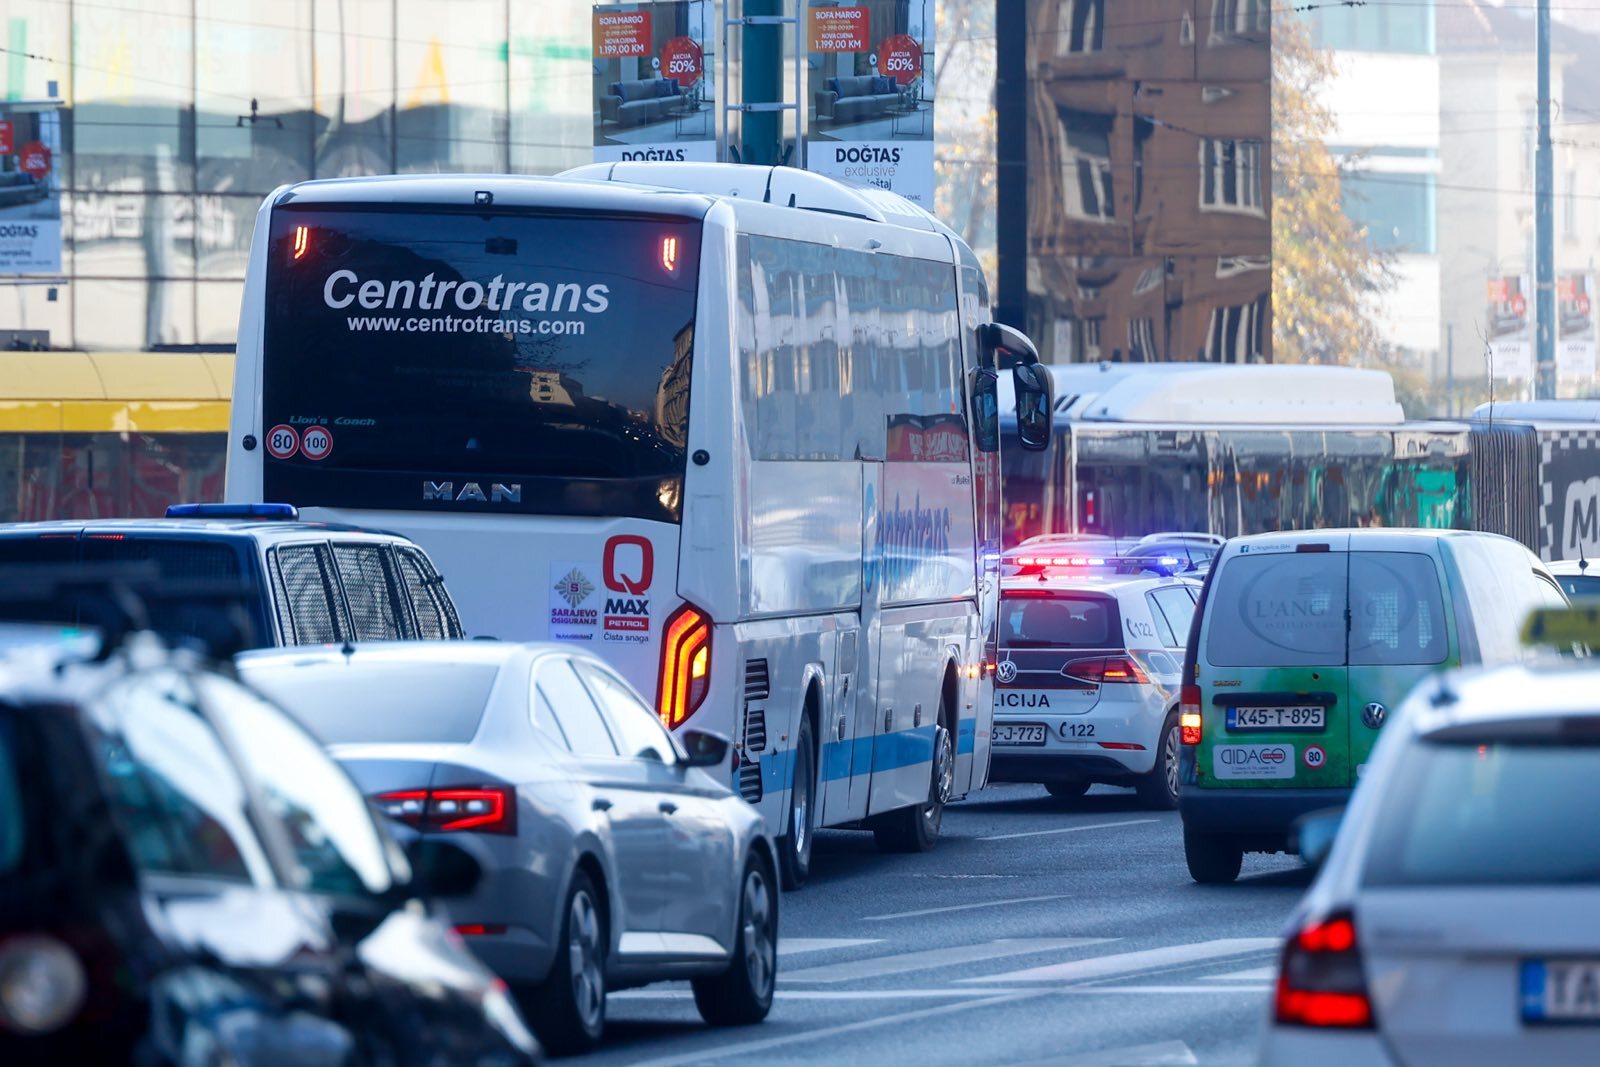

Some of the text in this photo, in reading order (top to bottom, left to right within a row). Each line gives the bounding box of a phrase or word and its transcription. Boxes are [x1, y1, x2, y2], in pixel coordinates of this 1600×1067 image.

[599, 15, 643, 25] SOFA MARGO
[815, 11, 834, 19] SOFA
[631, 44, 644, 52] KM
[848, 40, 861, 49] KM
[669, 60, 695, 73] 50%
[887, 58, 914, 71] 50%
[844, 164, 896, 177] exclusive
[323, 269, 610, 313] Centrotrans
[347, 314, 585, 335] www.centrotrans.com
[289, 415, 328, 424] Lion's
[273, 434, 293, 449] 80
[305, 436, 327, 449] 100
[423, 481, 521, 503] MAN
[602, 534, 654, 596] Q
[551, 608, 597, 617] SARAJEVO
[604, 599, 649, 615] MAX
[551, 617, 597, 625] OSIGURANJE
[1134, 622, 1154, 637] 122
[603, 632, 623, 641] Čista
[625, 634, 649, 644] snaga
[1237, 708, 1321, 725] K45-T-895
[1070, 724, 1095, 737] 122
[1308, 752, 1320, 762] 80
